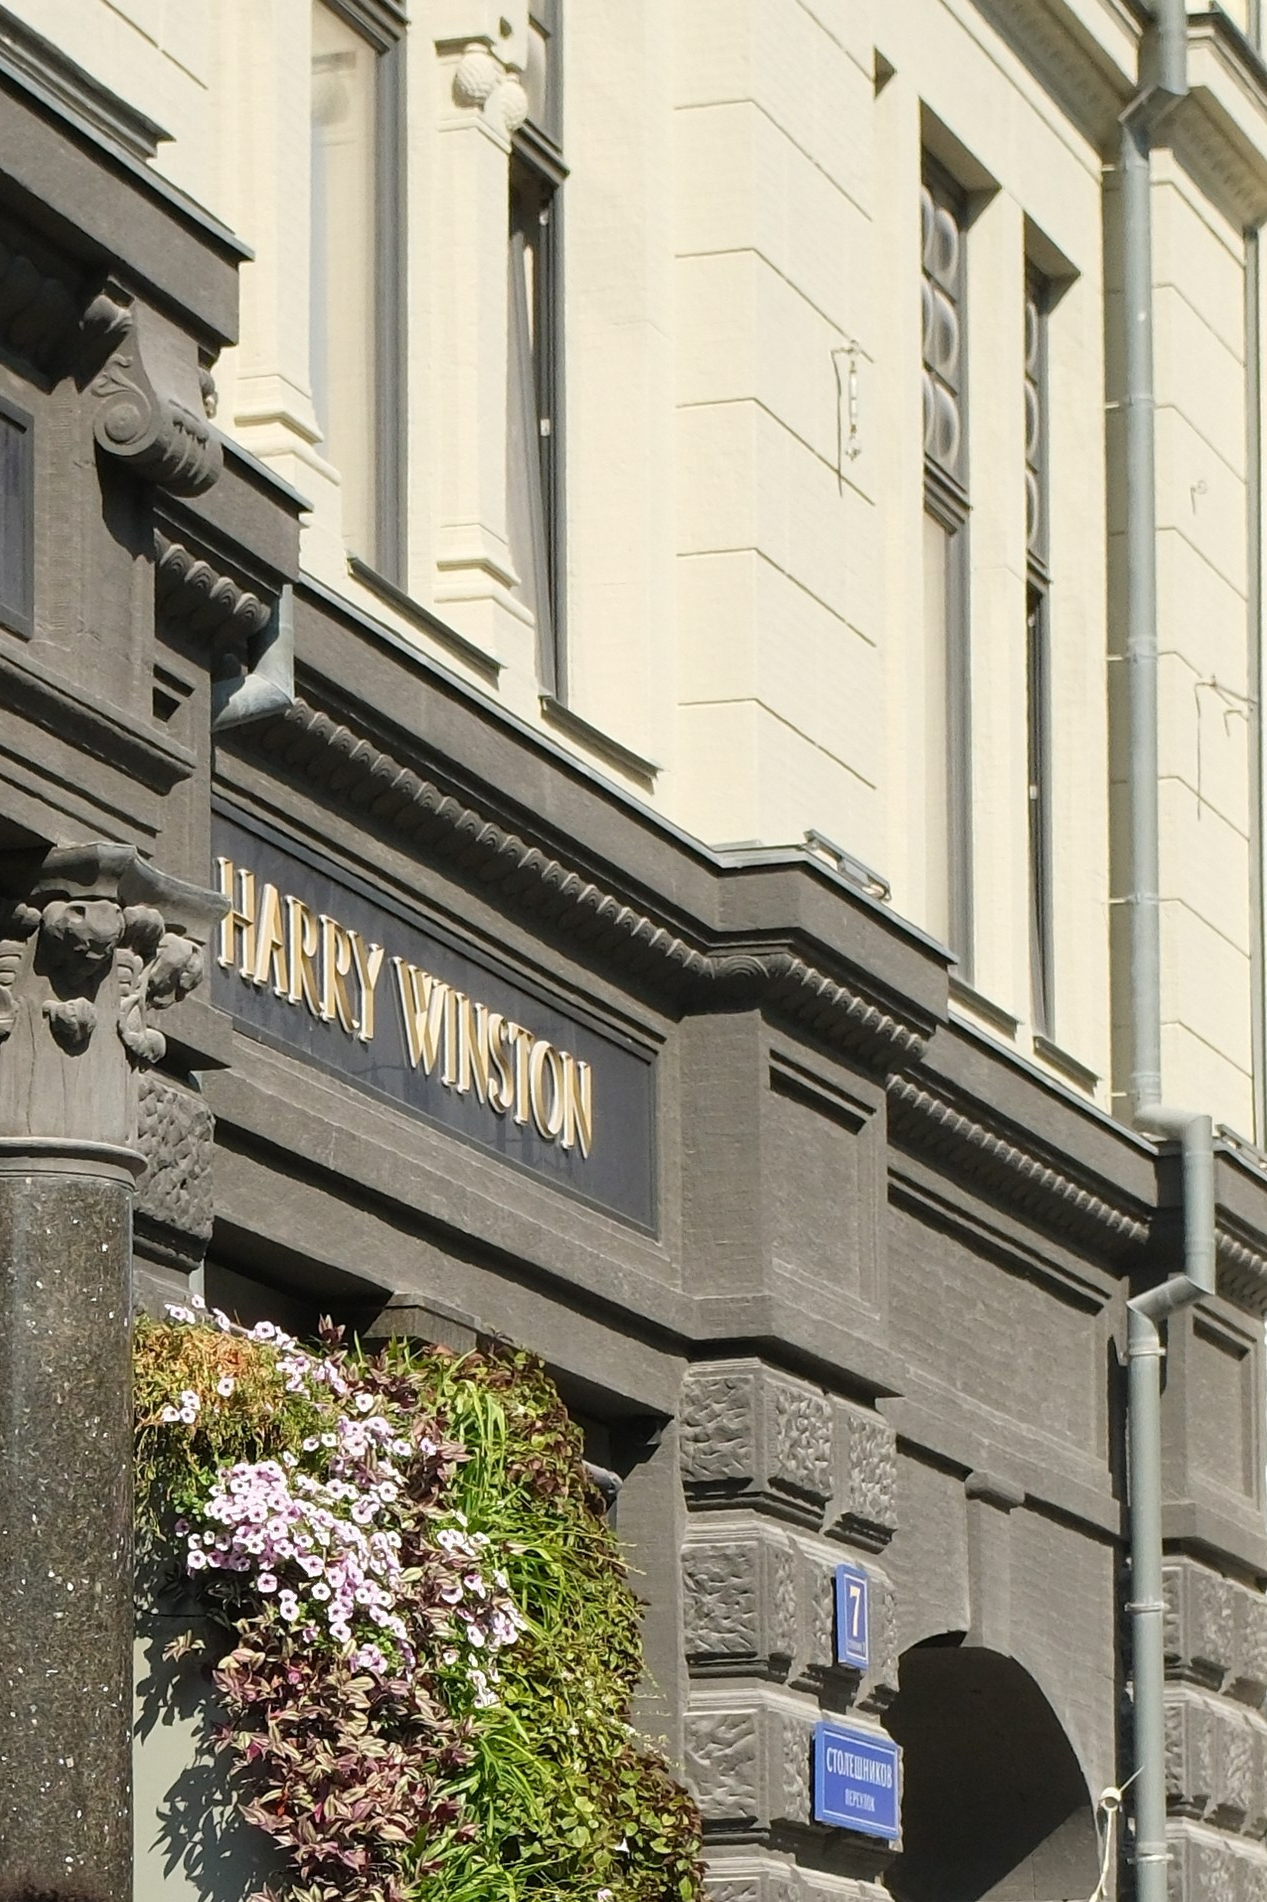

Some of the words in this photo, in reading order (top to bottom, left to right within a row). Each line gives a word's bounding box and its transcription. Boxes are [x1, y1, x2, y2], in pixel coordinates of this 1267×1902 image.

[216, 856, 385, 1044] HARRY
[391, 956, 593, 1160] WINSTON
[849, 1585, 861, 1637] 7
[826, 1746, 893, 1789] СТОЛЕШНИКОВ
